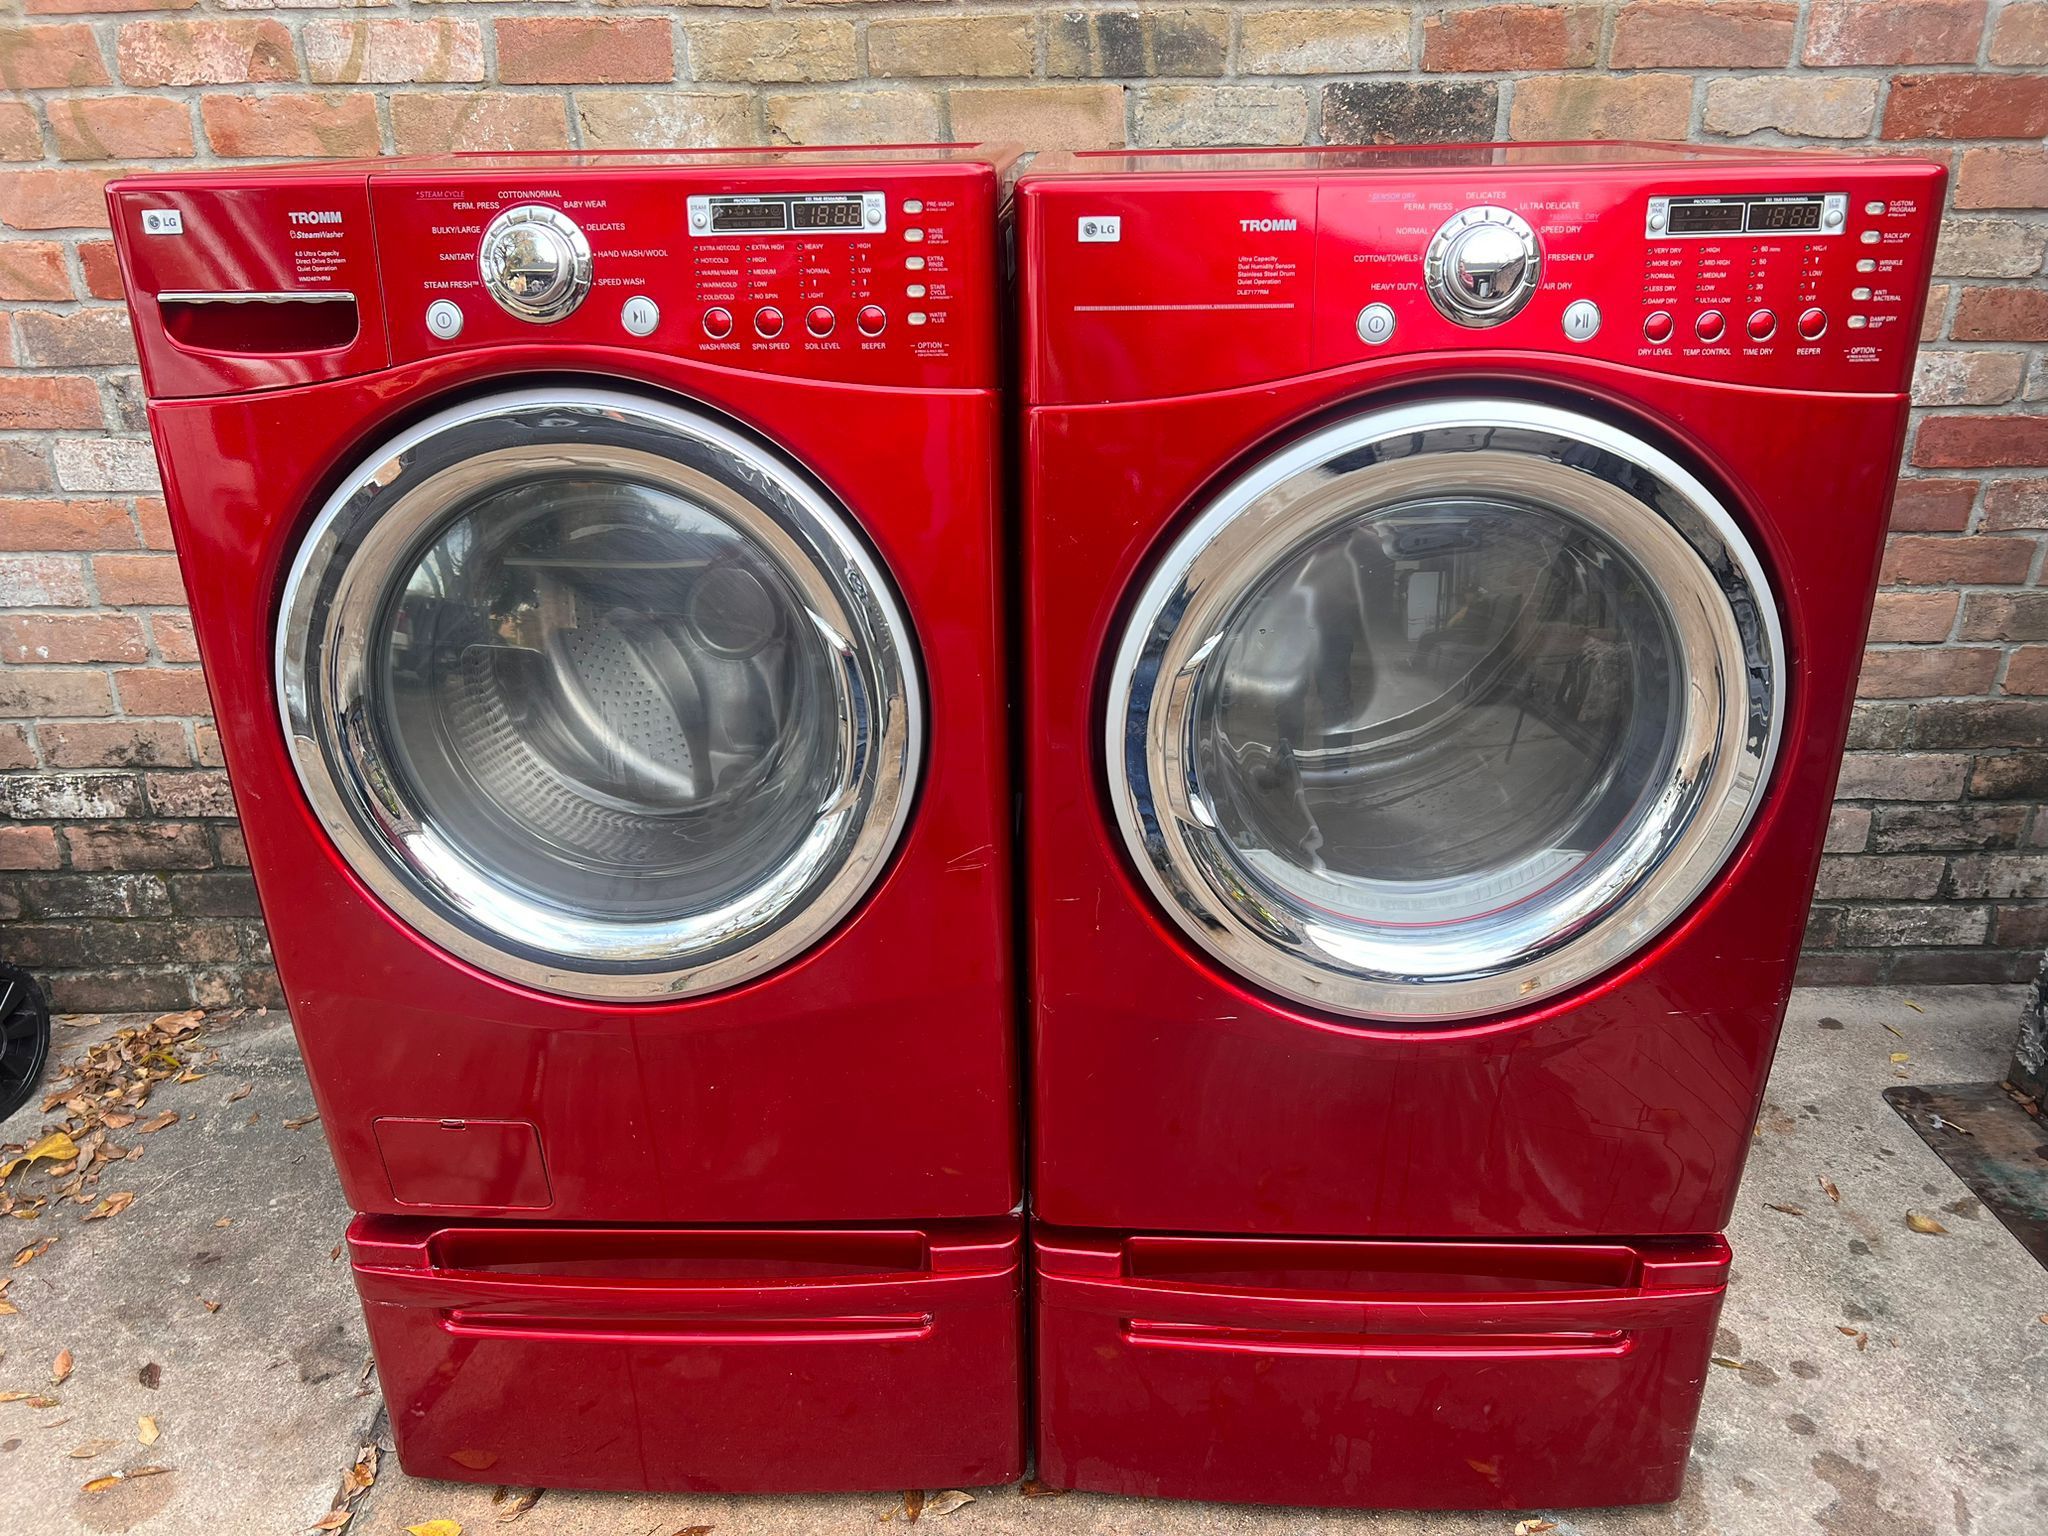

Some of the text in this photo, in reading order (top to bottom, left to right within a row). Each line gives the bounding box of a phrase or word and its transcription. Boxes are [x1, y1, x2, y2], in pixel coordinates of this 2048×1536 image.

[498, 190, 562, 199] COTTON/NORMAL
[1466, 192, 1506, 200] DELICATES
[163, 217, 176, 226] LG
[288, 211, 342, 224] TROMM
[432, 226, 480, 234] BULKY/LARGE
[1101, 225, 1115, 234] LG
[1239, 219, 1297, 232] TROMM
[296, 230, 344, 238] SteamWasher
[1354, 254, 1418, 263] COTTON/TOWELS
